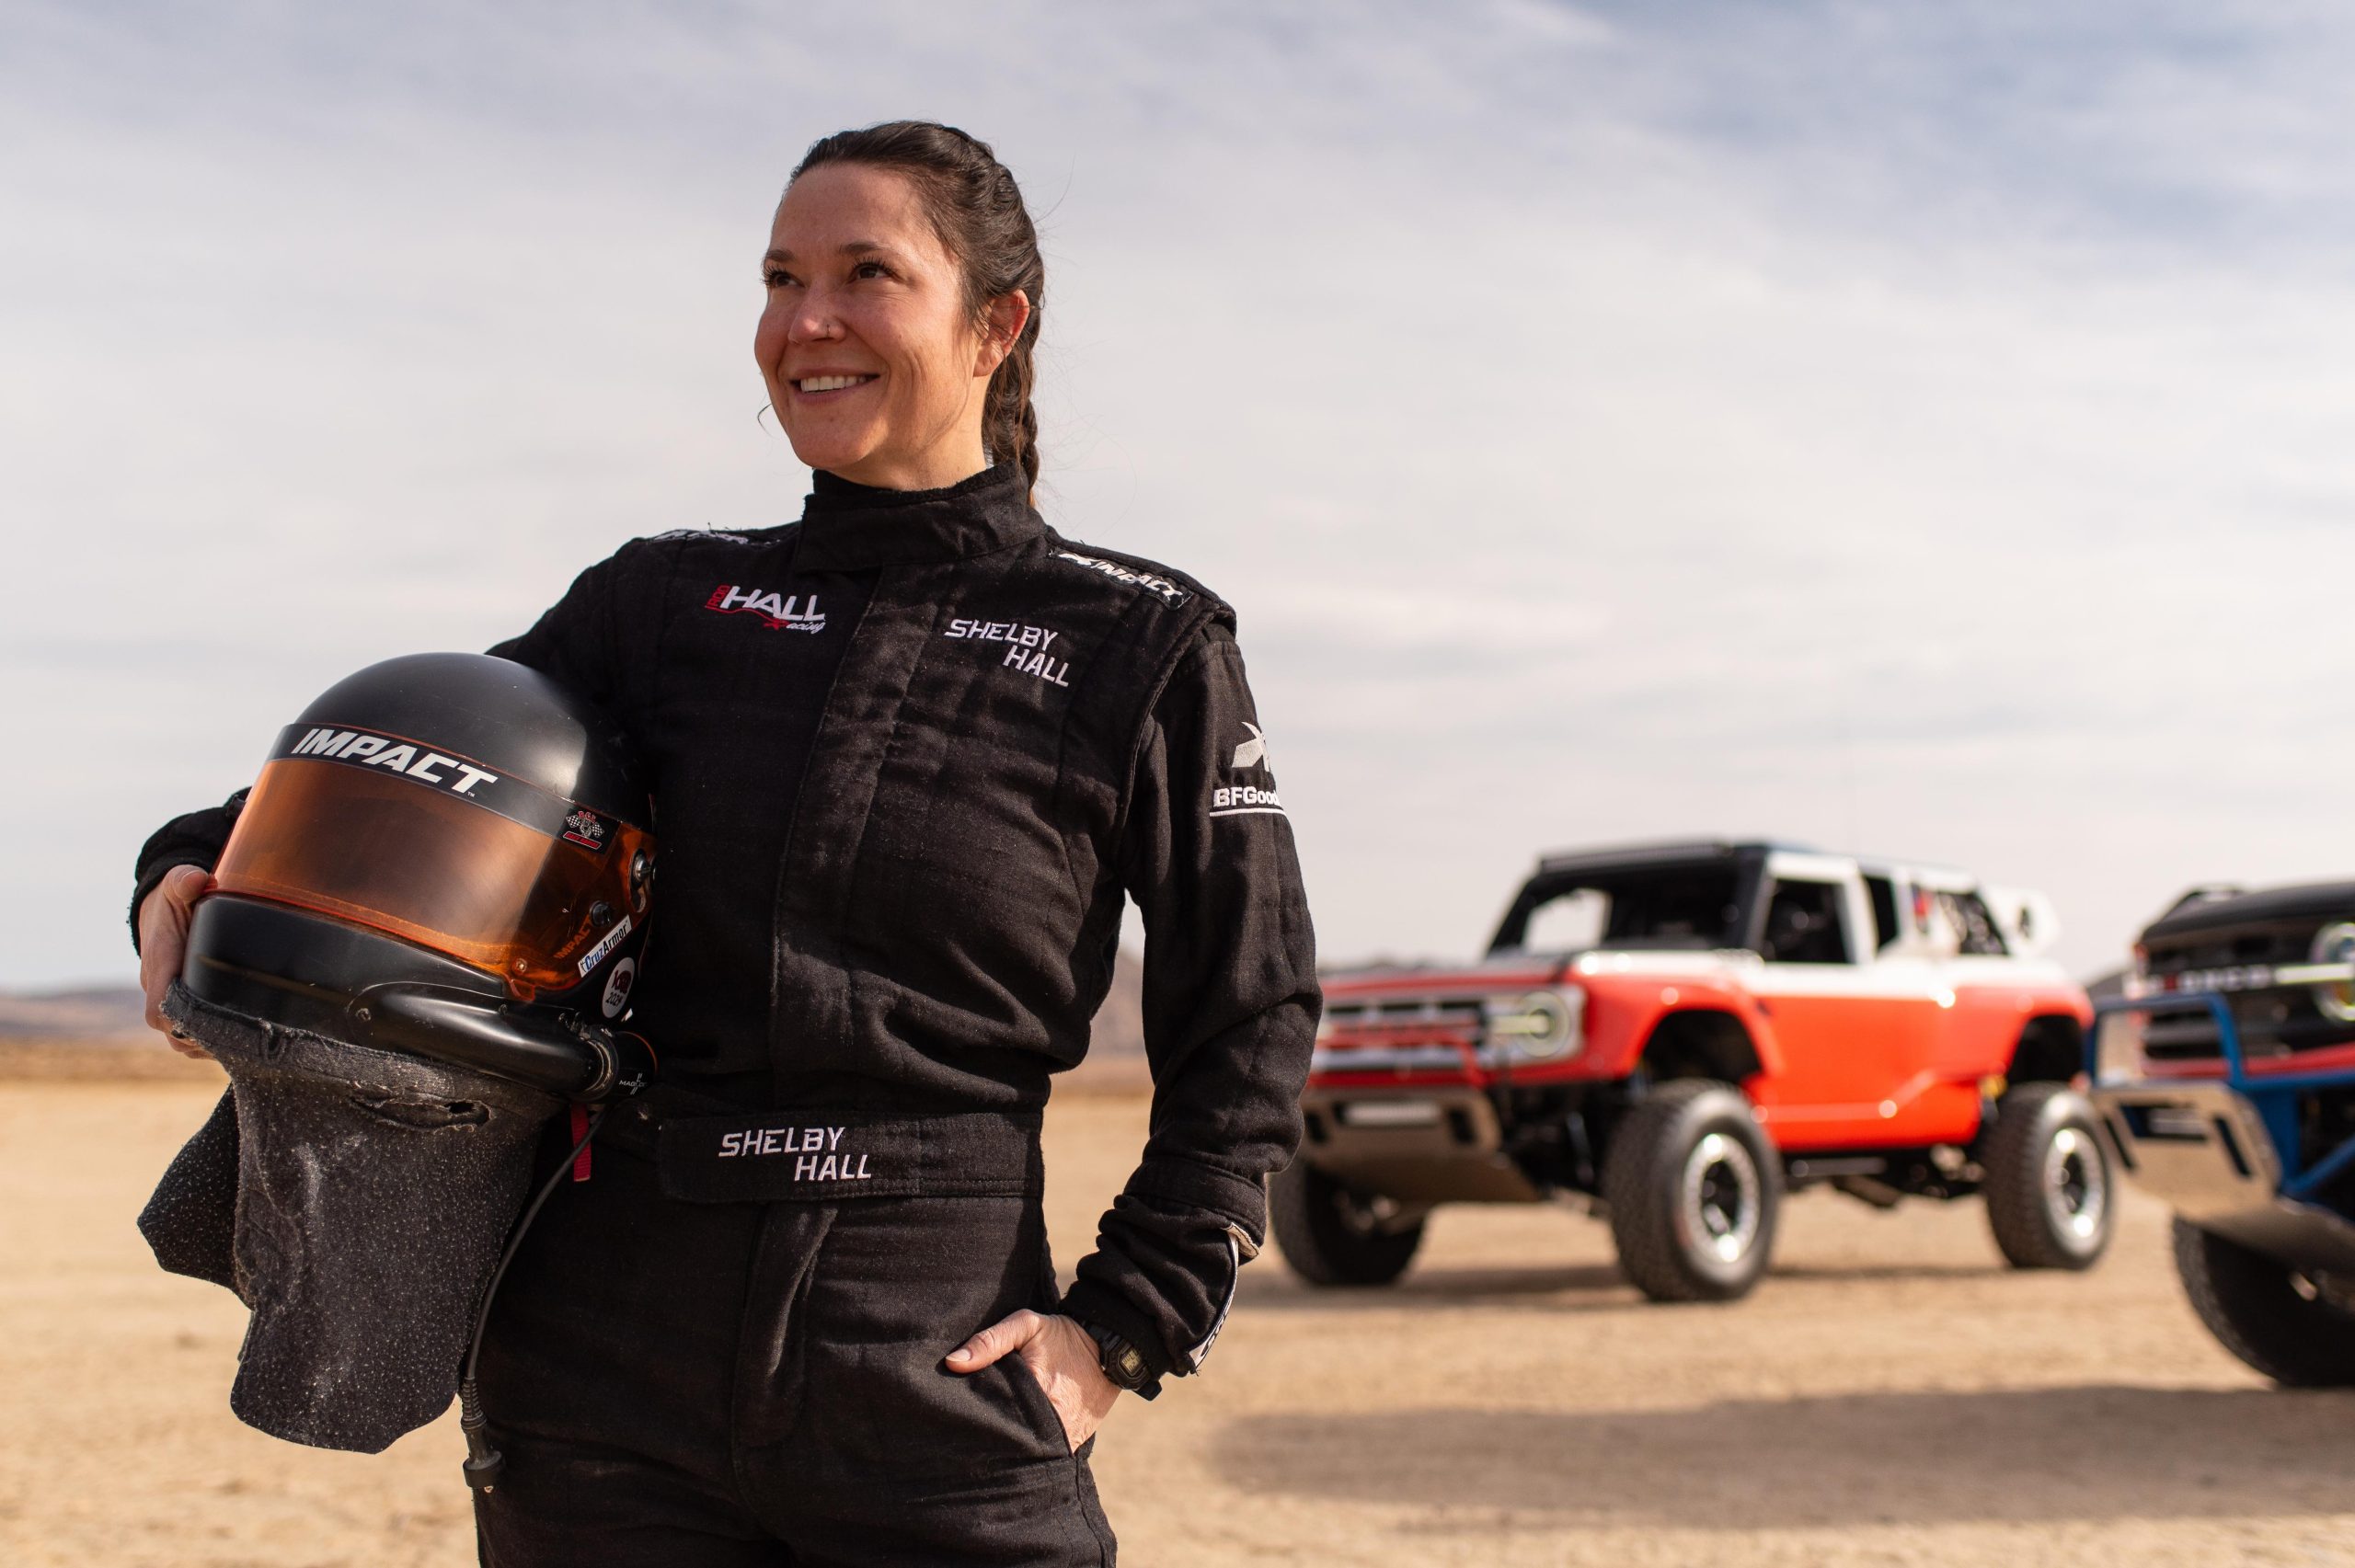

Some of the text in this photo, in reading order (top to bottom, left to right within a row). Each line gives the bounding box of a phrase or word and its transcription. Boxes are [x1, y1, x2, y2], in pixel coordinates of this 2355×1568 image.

[719, 586, 825, 622] HALL
[944, 619, 1059, 651] SHELBY
[1002, 645, 1070, 687] HALL
[291, 728, 499, 794] IMPACT
[718, 1127, 846, 1157] SHELBY
[794, 1154, 872, 1182] HALL
